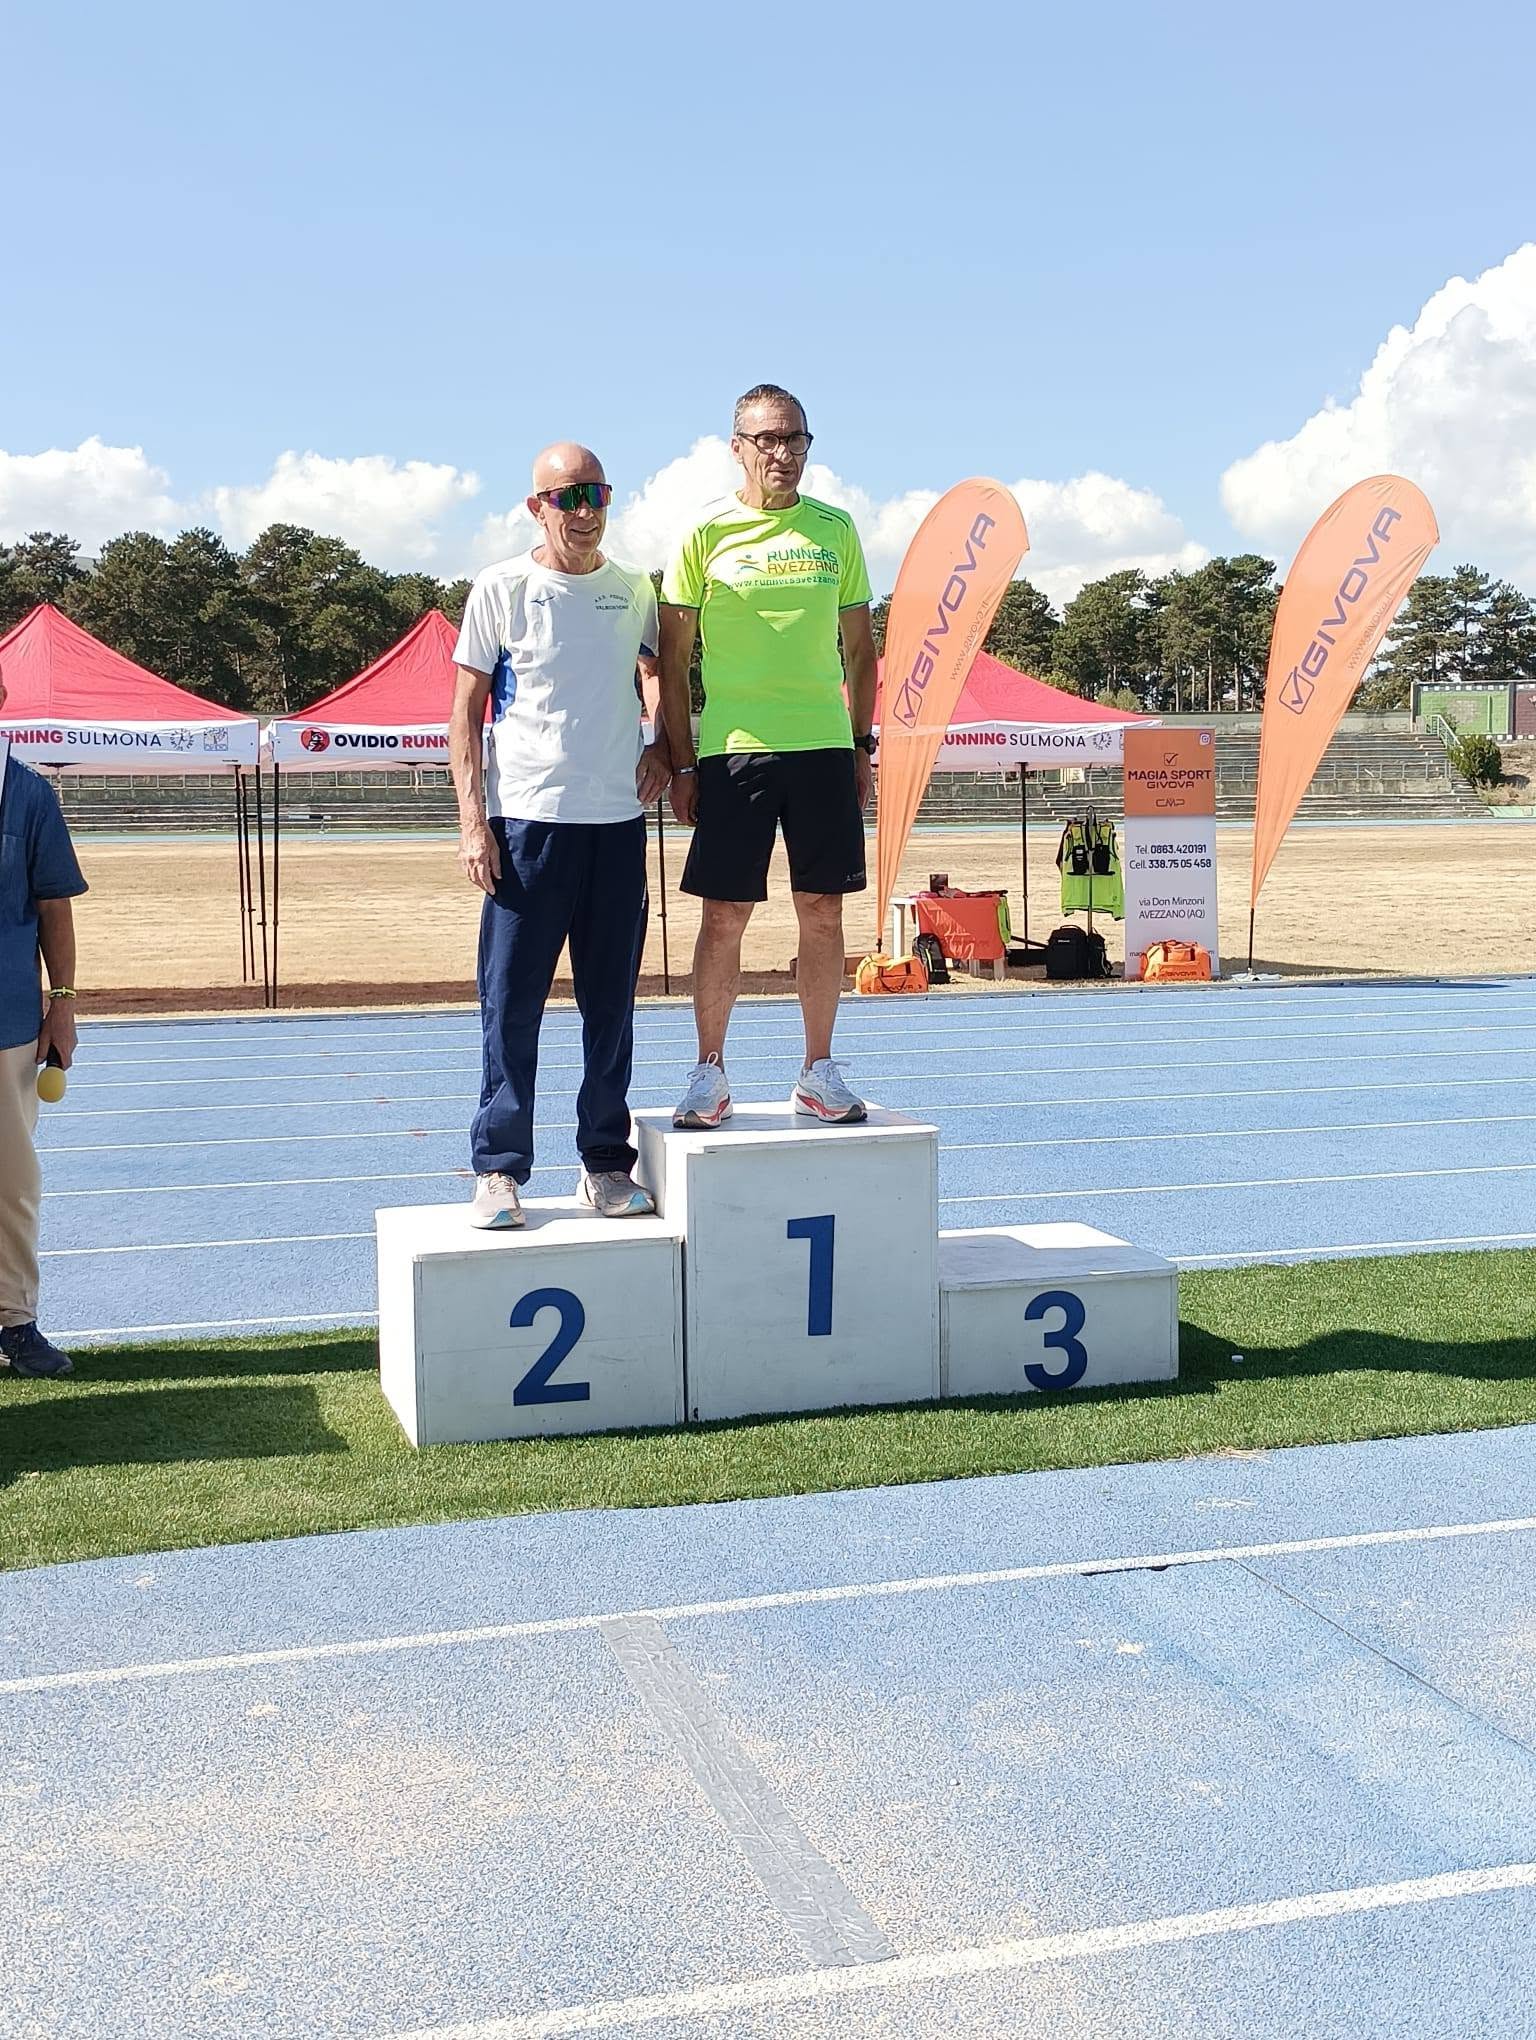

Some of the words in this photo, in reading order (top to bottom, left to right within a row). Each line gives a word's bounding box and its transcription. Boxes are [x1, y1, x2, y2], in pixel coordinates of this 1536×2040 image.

[767, 548, 838, 563] RUNNERS
[767, 560, 839, 574] AVEZZANO
[1301, 507, 1402, 678] GIVOVA
[911, 513, 996, 690] GIVOVA
[67, 731, 162, 747] SULMONA
[334, 734, 399, 748] OVIDIO
[941, 733, 1007, 746] UNNING
[1009, 734, 1086, 747] SULMONA
[1128, 770, 1168, 780] MAGIA
[1170, 770, 1212, 780] SPORT
[1146, 781, 1194, 789] GIVOVA
[1155, 798, 1186, 807] CMP
[1135, 845, 1150, 855] Tel.
[1148, 859, 1179, 869] 338.75
[1180, 859, 1192, 868] 05
[1193, 859, 1212, 868] 458
[1139, 897, 1151, 906] via
[1152, 897, 1171, 906] Don
[1172, 896, 1205, 906] Minzoni
[1138, 910, 1186, 919] AVEZZANO
[1187, 909, 1206, 919] (AQ)
[787, 1214, 836, 1336] 1
[509, 1287, 591, 1407] 2
[1023, 1290, 1089, 1391] 3
